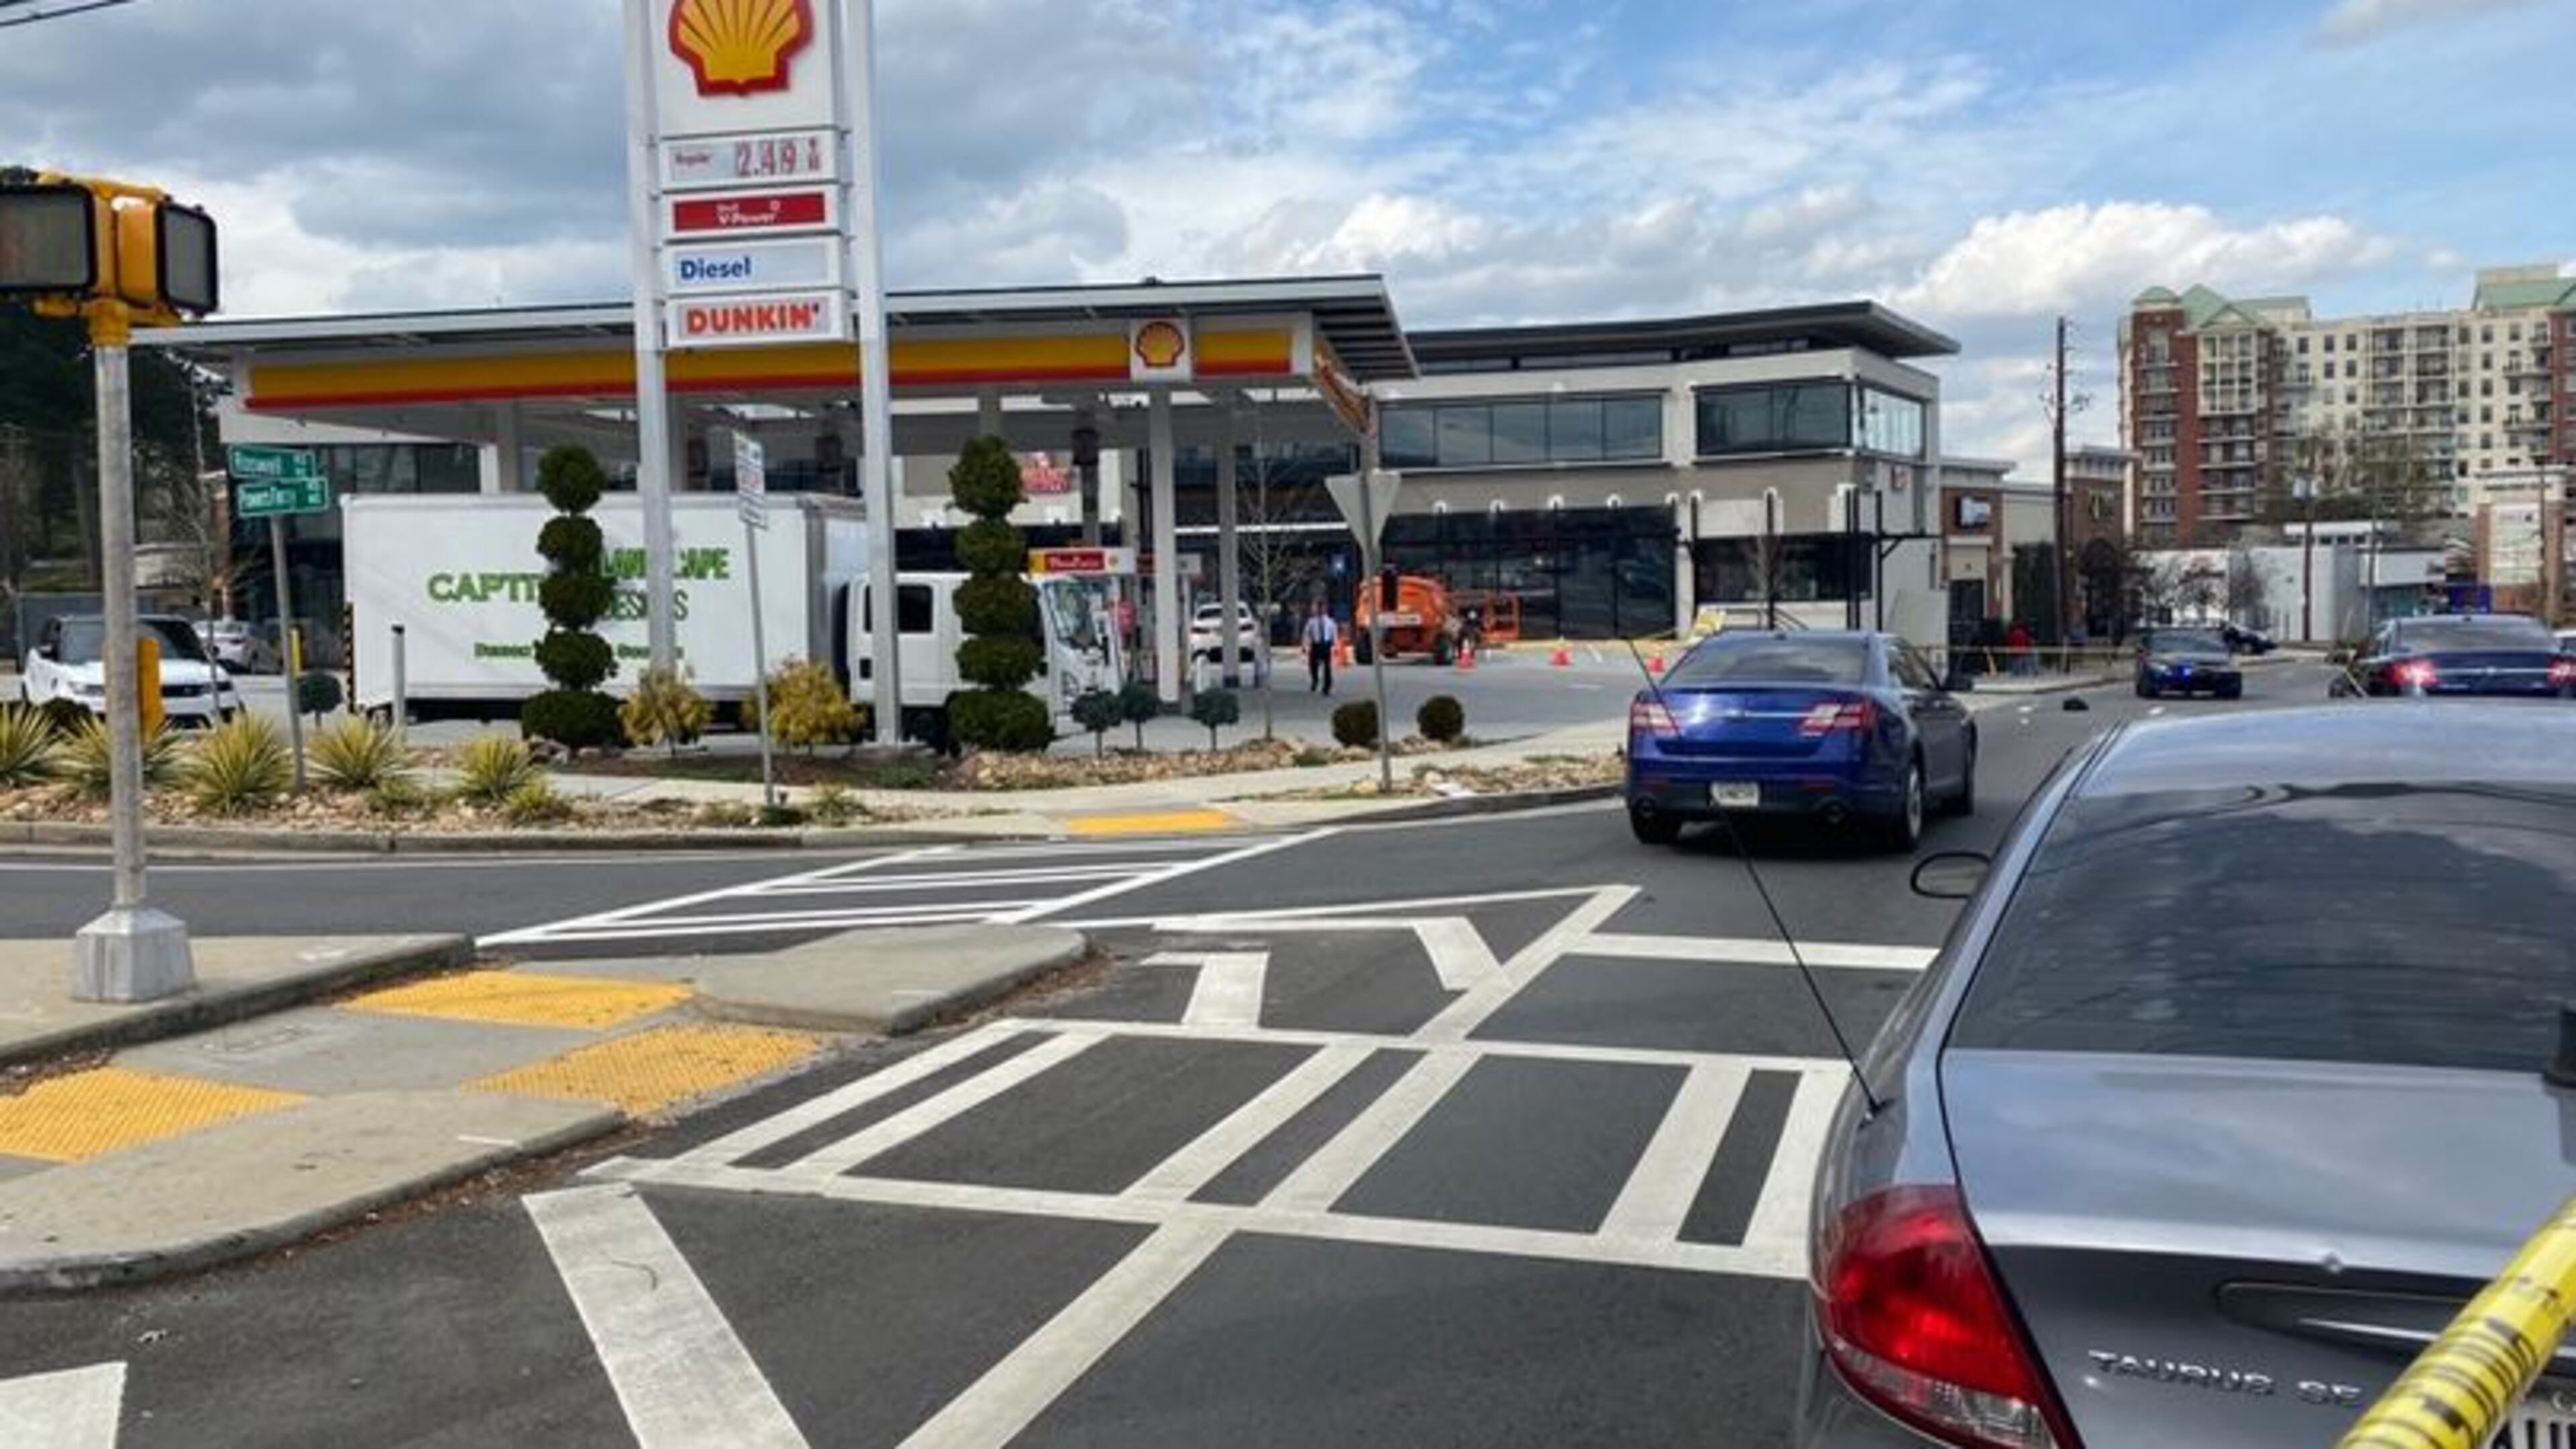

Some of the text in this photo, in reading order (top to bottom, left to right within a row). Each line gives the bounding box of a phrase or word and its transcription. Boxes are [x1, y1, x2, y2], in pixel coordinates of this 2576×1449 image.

[680, 256, 751, 280] Diesel
[686, 303, 820, 334] DUNKIN'
[2088, 1348, 2363, 1405] TAURUS SE
